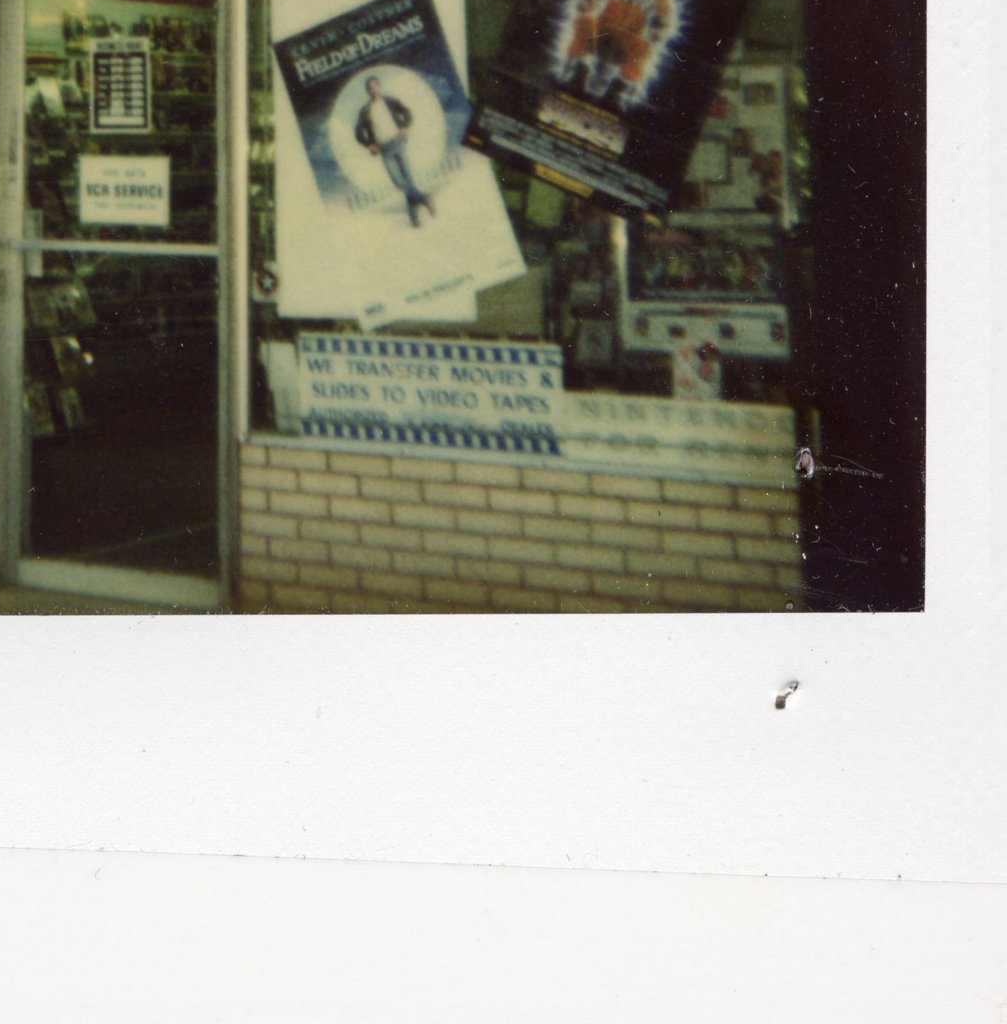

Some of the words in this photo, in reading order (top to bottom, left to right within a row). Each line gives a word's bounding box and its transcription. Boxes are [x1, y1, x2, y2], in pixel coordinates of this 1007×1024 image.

[294, 51, 343, 82] FIELD
[357, 15, 423, 55] DREAMS
[86, 183, 110, 198] VCR
[114, 184, 164, 200] SERVICE
[307, 356, 333, 374] WE
[347, 359, 440, 382] TRANSFER
[450, 367, 528, 386] MOVIES
[539, 371, 554, 389] &
[312, 382, 370, 401] SLIDES
[381, 386, 406, 404] TO
[416, 388, 479, 410] VIDEO
[490, 392, 551, 414] TAPES
